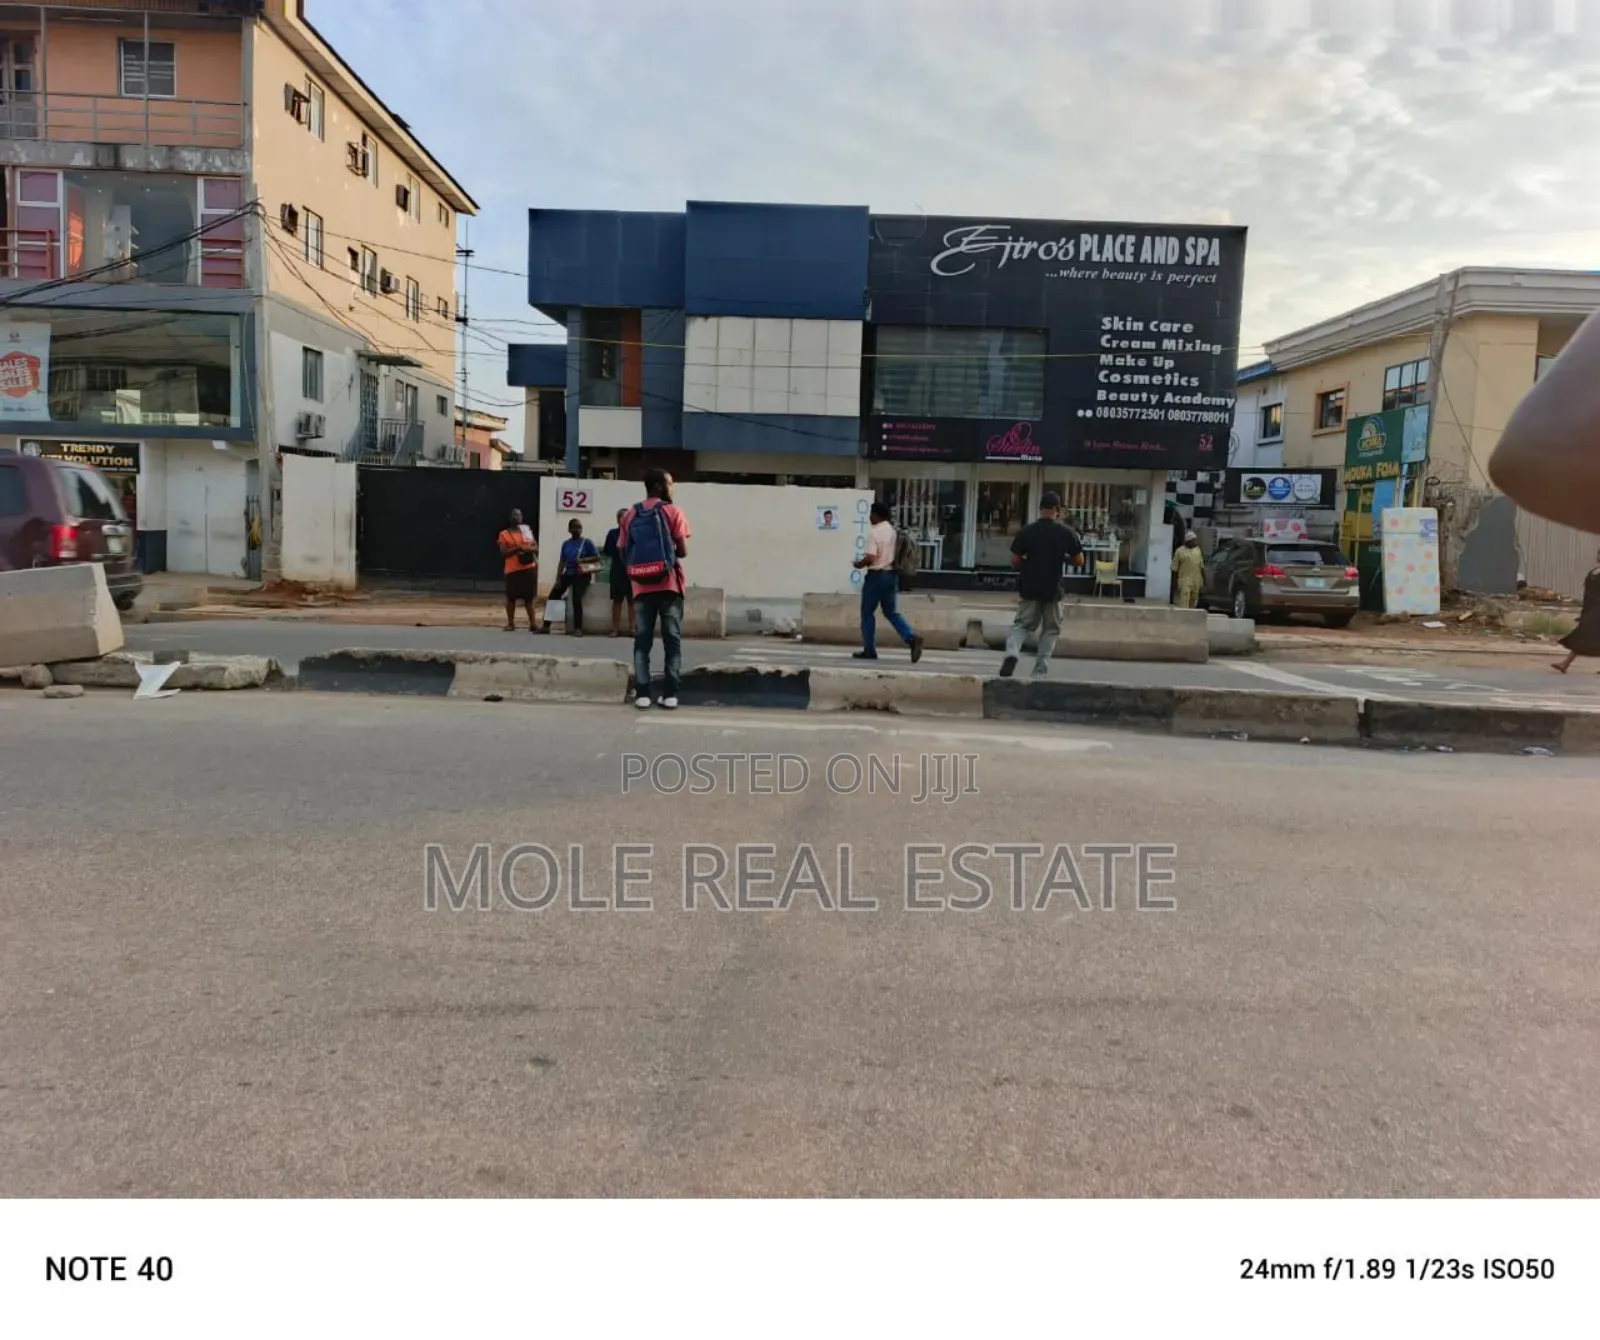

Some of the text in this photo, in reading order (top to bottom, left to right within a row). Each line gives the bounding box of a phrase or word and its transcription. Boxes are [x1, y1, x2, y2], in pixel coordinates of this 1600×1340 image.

[1079, 233, 1135, 263] PLACE
[1139, 236, 1178, 265] AND
[1184, 237, 1220, 266] SPA
[1101, 268, 1147, 283] beauty
[1150, 270, 1163, 282] is
[1166, 272, 1217, 288] perfect
[1101, 316, 1144, 331] Skin
[1100, 334, 1156, 350] Cream
[1100, 354, 1175, 370] Make Up
[1098, 370, 1200, 387] Cosmetics
[1096, 390, 1236, 408] Beauty Academy
[1096, 406, 1165, 420] 08035772501
[60, 443, 115, 455] TRENDY
[562, 490, 588, 508] 52
